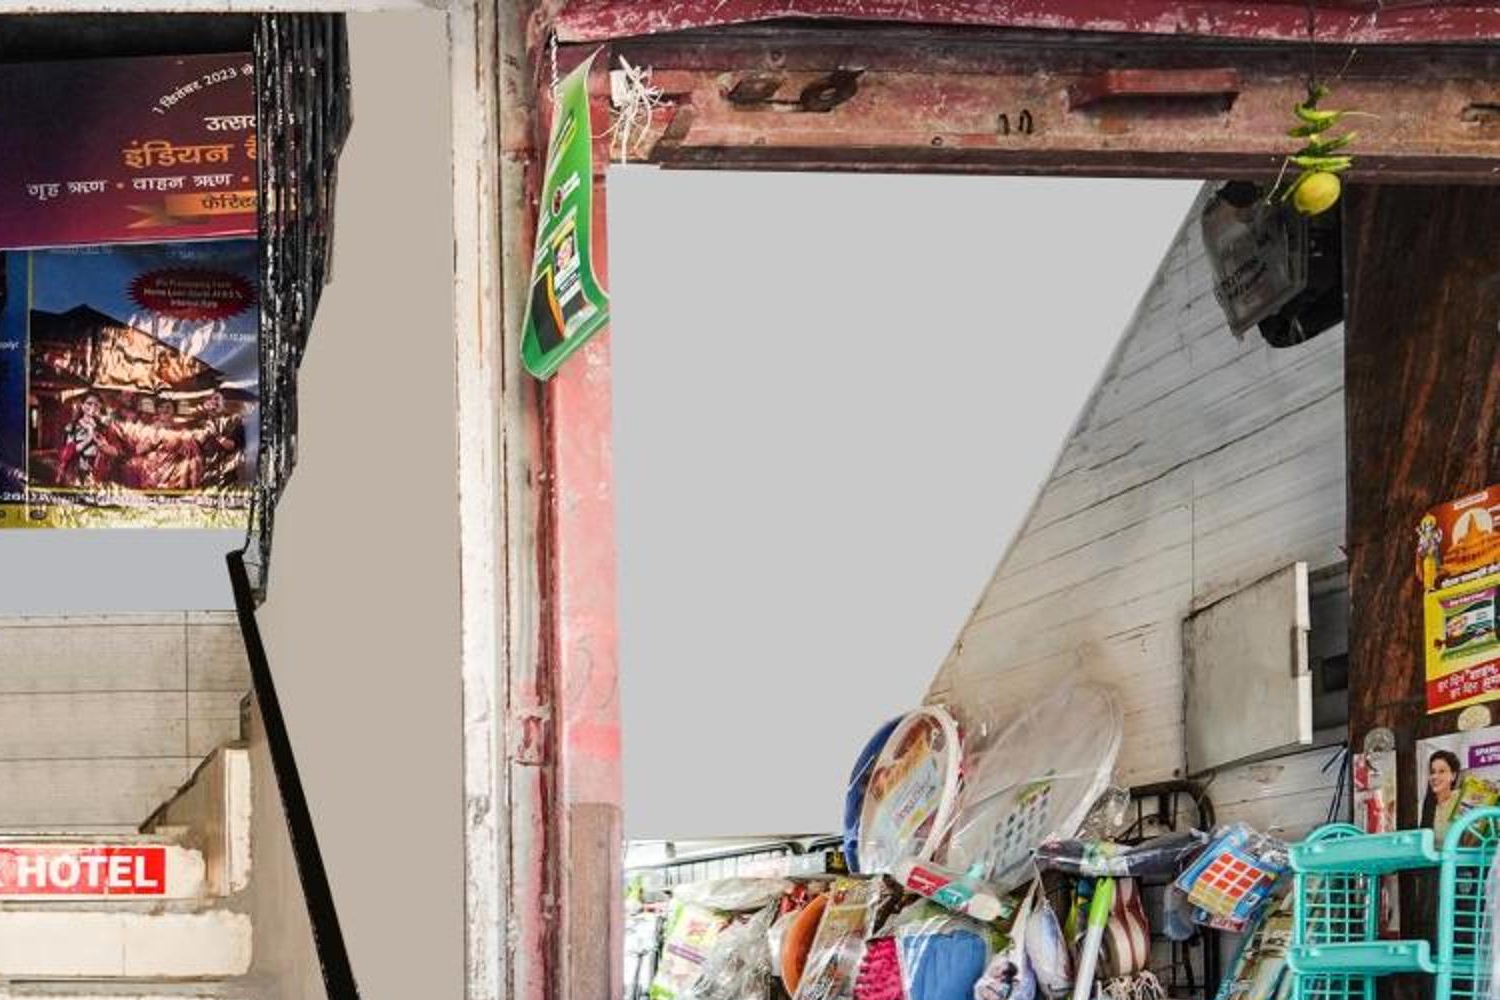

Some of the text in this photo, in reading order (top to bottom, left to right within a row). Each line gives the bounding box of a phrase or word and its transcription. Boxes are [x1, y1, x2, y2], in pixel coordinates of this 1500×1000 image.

[203, 67, 238, 86] 2023
[123, 139, 234, 169] इंडियन
[132, 175, 187, 191] वाहन
[21, 855, 159, 888] HOTEL
